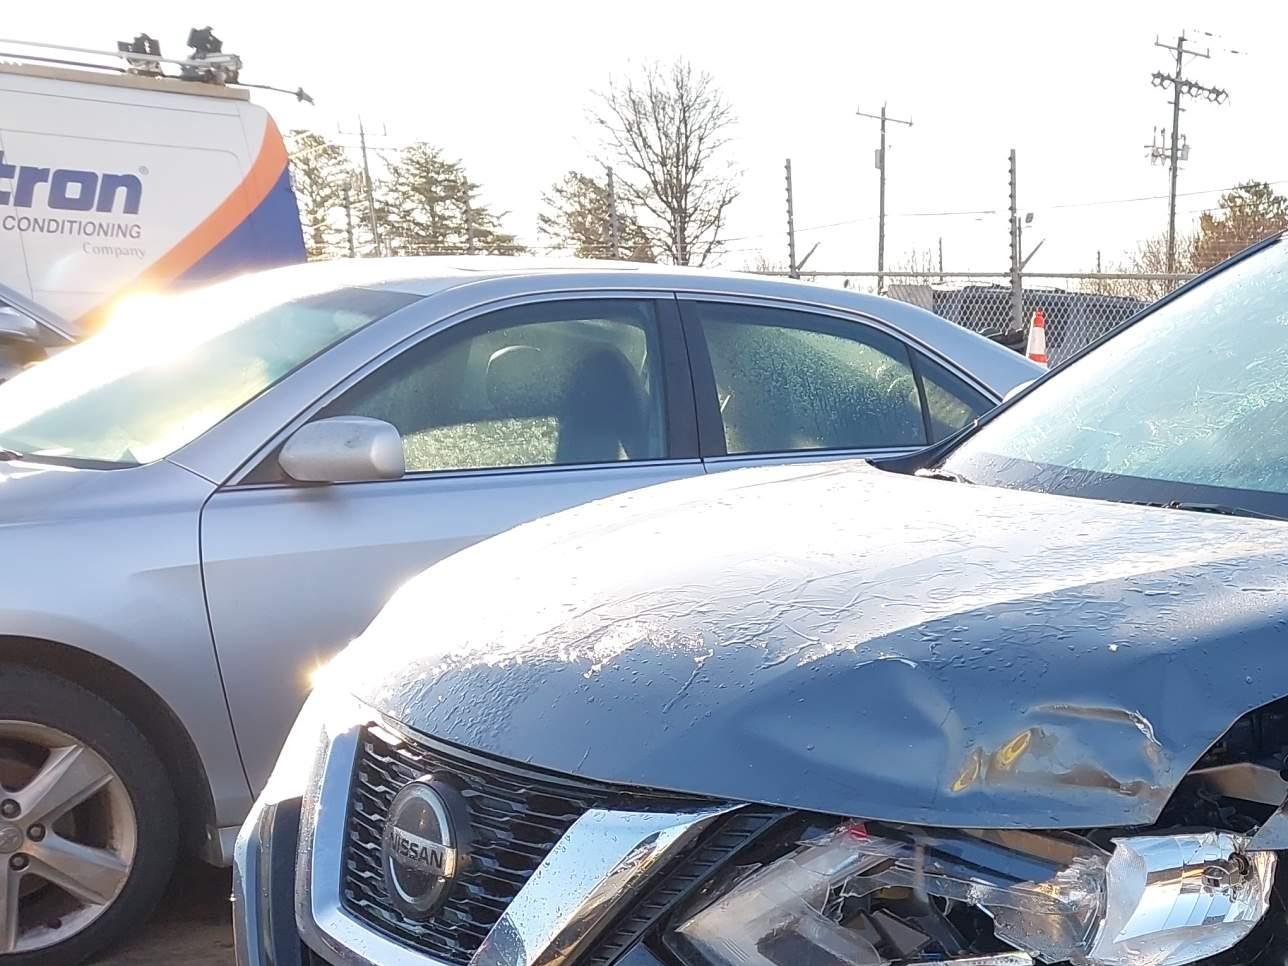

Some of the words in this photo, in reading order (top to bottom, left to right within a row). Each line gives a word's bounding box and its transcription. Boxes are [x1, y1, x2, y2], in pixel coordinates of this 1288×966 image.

[2, 215, 142, 239] CONDITIONING
[82, 241, 146, 259] Company
[389, 831, 444, 869] NISSAN
